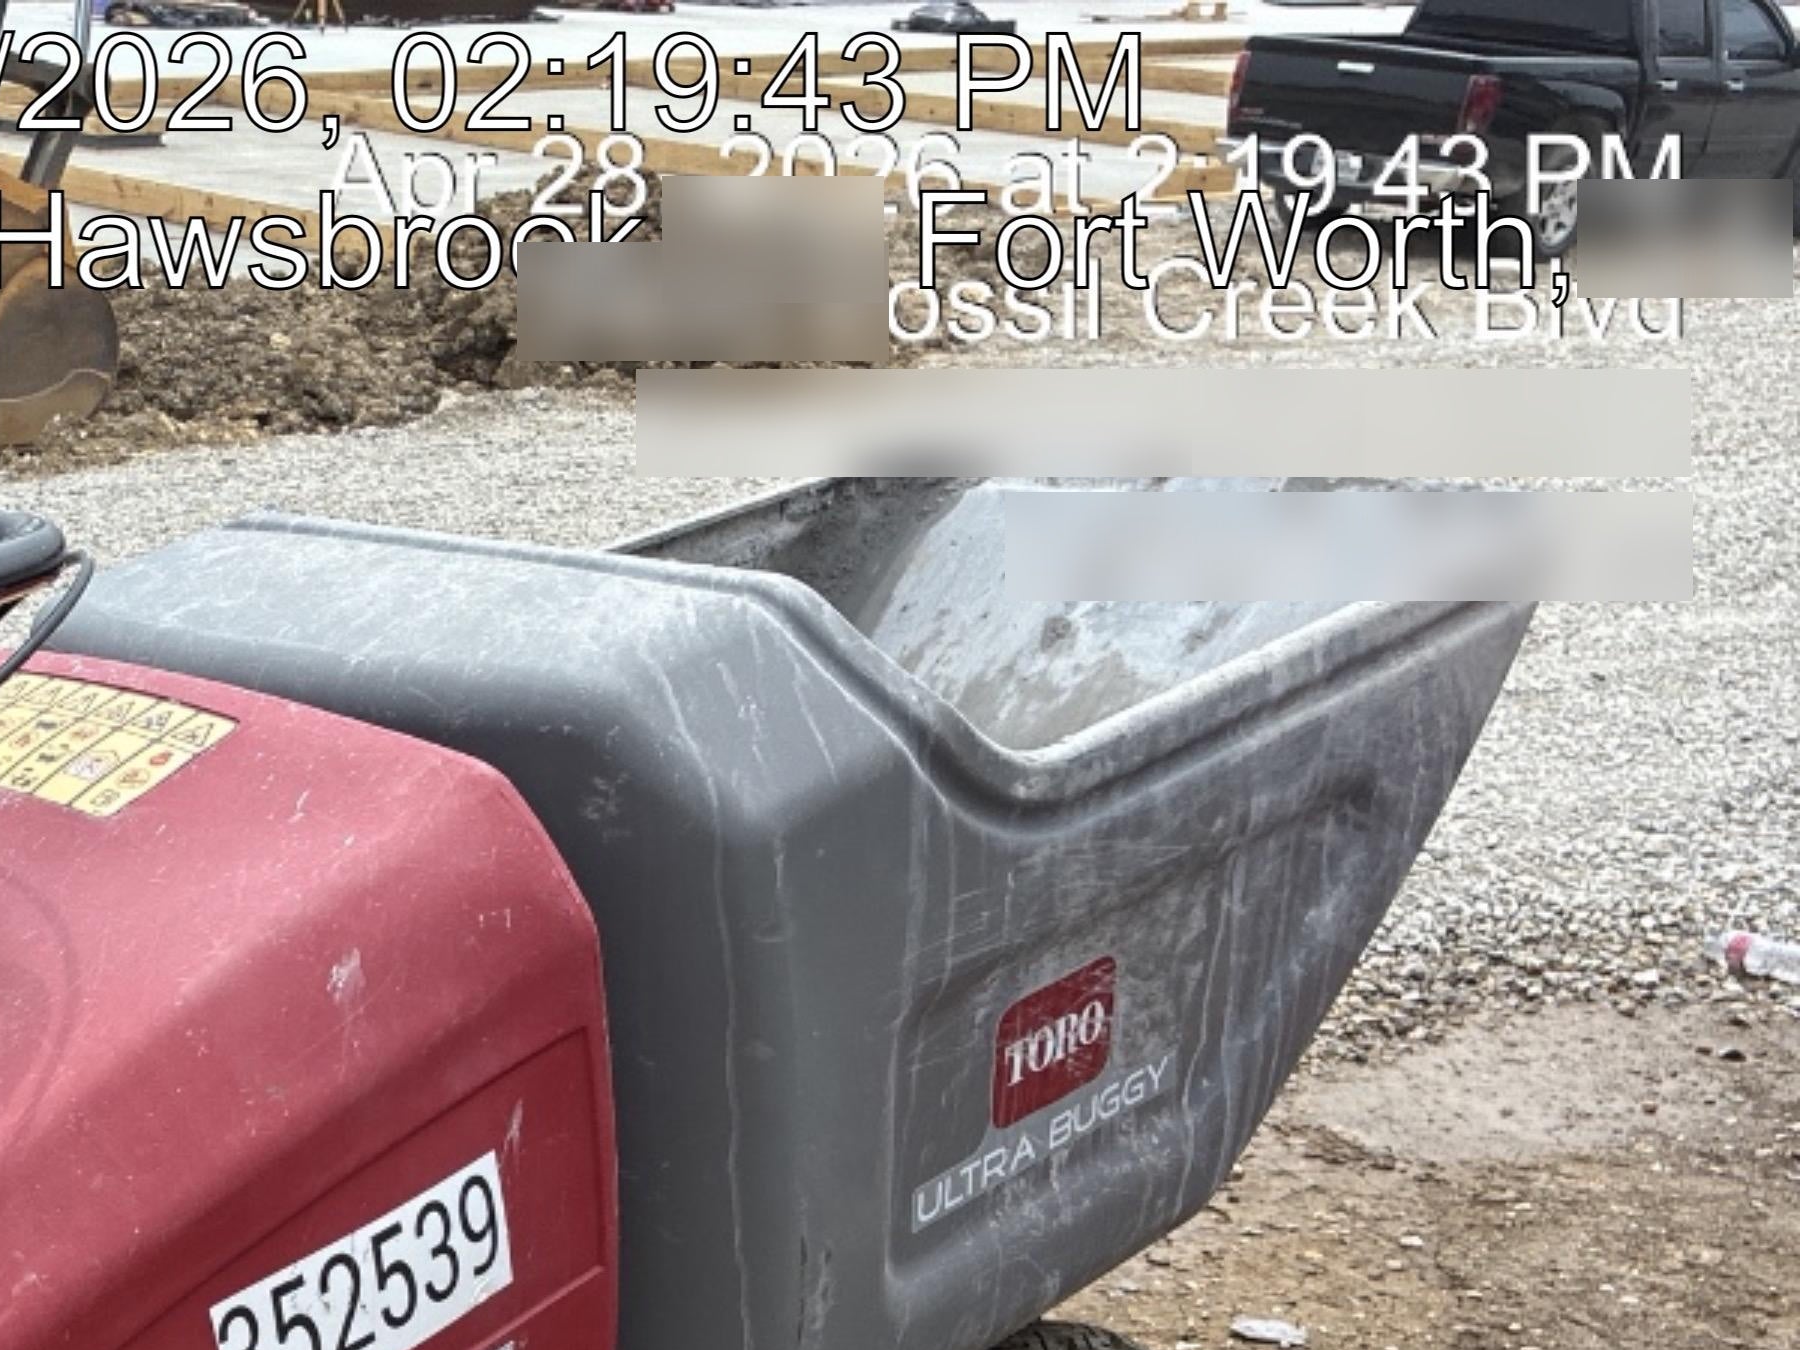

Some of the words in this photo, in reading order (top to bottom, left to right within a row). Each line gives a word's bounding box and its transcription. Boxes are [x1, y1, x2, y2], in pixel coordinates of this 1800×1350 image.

[1004, 999, 1106, 1087] TORO
[916, 1135, 1036, 1223] ULTRA
[1049, 1055, 1169, 1150] BUGGY
